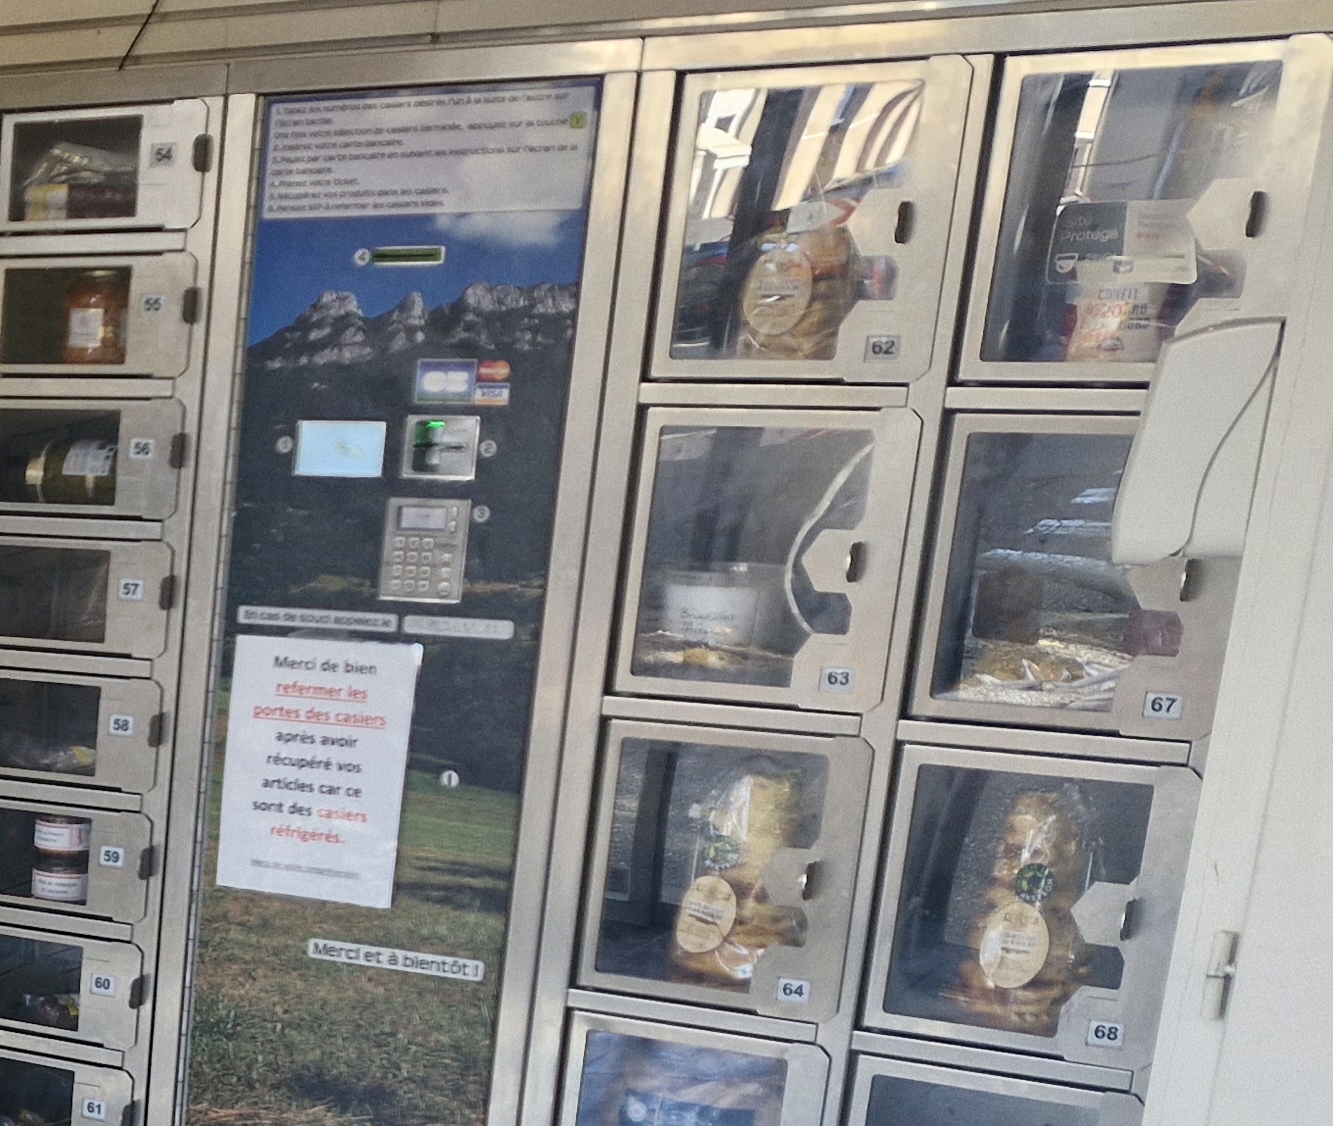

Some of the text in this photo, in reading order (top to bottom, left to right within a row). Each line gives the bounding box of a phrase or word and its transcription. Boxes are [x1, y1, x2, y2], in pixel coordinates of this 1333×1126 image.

[155, 148, 172, 162] 54
[144, 298, 161, 312] 55
[872, 340, 895, 354] 62
[135, 442, 150, 455] 56
[123, 583, 139, 595] 57
[273, 656, 378, 675] Merci de bien
[828, 672, 849, 685] 63
[275, 680, 368, 700] refermer les
[1151, 697, 1177, 712] 67
[252, 703, 387, 727] portes des casiers
[113, 719, 129, 731] 58
[275, 729, 359, 748] après avoir
[266, 752, 362, 773] récupéré vos
[261, 776, 362, 798] articles car ce
[252, 799, 368, 823] sont des casiers
[104, 850, 120, 863] 59
[312, 941, 361, 963] Merci
[364, 947, 383, 964] et
[387, 948, 399, 966] à
[402, 952, 469, 977] bientôt
[95, 977, 110, 990] 60
[783, 983, 803, 997] 64
[1095, 1025, 1118, 1040] 68
[87, 1103, 103, 1115] 61
